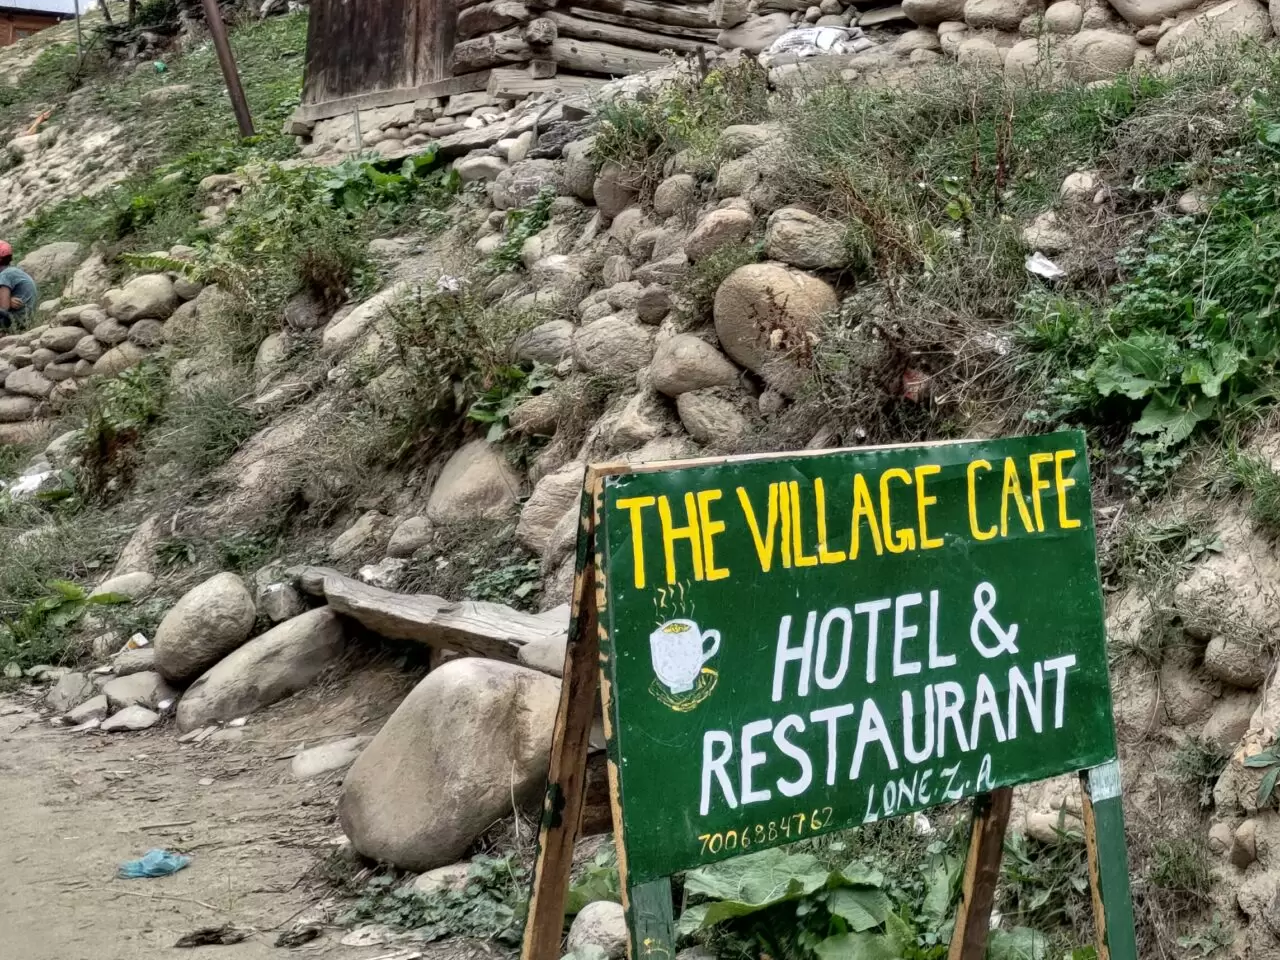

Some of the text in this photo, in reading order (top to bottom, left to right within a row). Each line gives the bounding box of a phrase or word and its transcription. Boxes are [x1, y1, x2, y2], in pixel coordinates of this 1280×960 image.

[616, 449, 1082, 589] THE VILLAGE CAFE
[771, 581, 1019, 702] HOTEL &
[699, 654, 1077, 816] RESTAURANT
[698, 806, 833, 855] 7006884762
